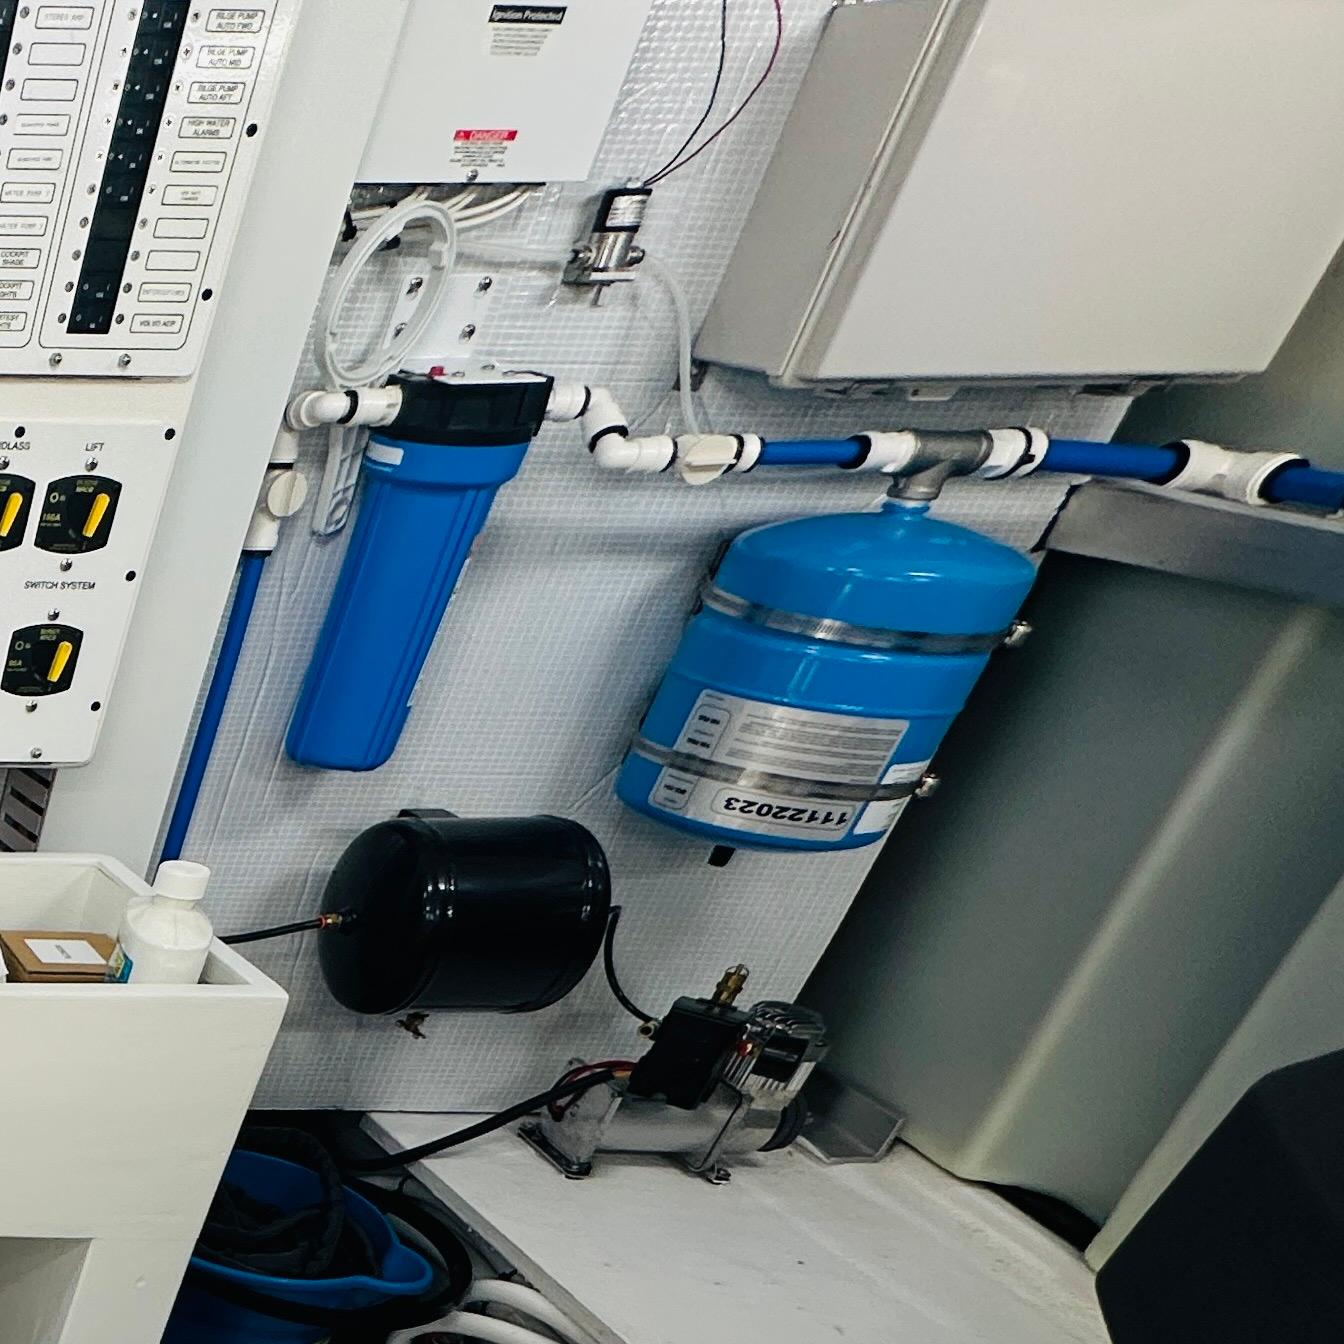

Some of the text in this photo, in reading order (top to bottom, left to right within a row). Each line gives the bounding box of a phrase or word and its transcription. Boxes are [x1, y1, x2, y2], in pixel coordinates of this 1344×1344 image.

[237, 12, 258, 20] PUMP
[85, 442, 104, 452] LIFT
[24, 581, 96, 590] SWITCH SYSTEM
[723, 796, 848, 828] 11122023
